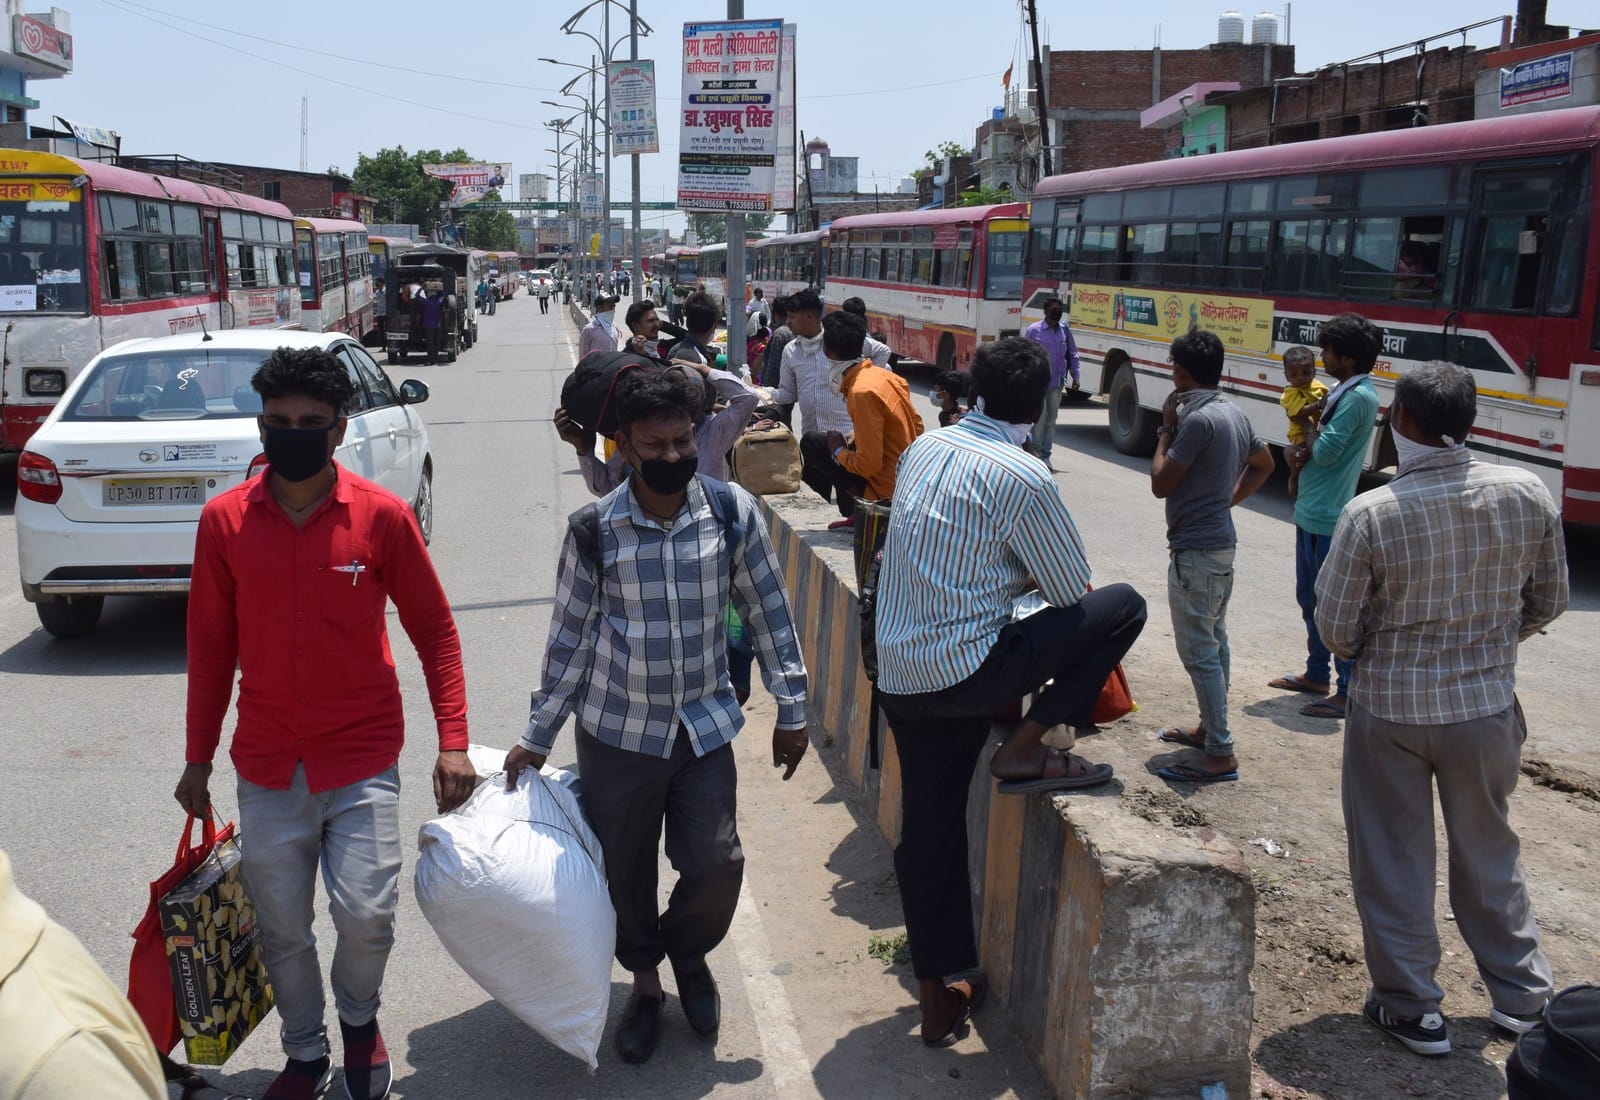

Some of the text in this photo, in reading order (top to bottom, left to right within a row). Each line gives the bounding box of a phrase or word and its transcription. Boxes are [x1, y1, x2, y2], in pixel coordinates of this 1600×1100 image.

[686, 39, 700, 56] रमा
[703, 33, 724, 55] मल्टी
[745, 105, 774, 128] सिंह
[0, 183, 34, 198] वहन
[470, 175, 488, 185] FREE
[148, 487, 163, 501] BT
[169, 486, 199, 499] 1777
[180, 951, 192, 976] LEAF
[185, 978, 199, 1018] GOLDEN
